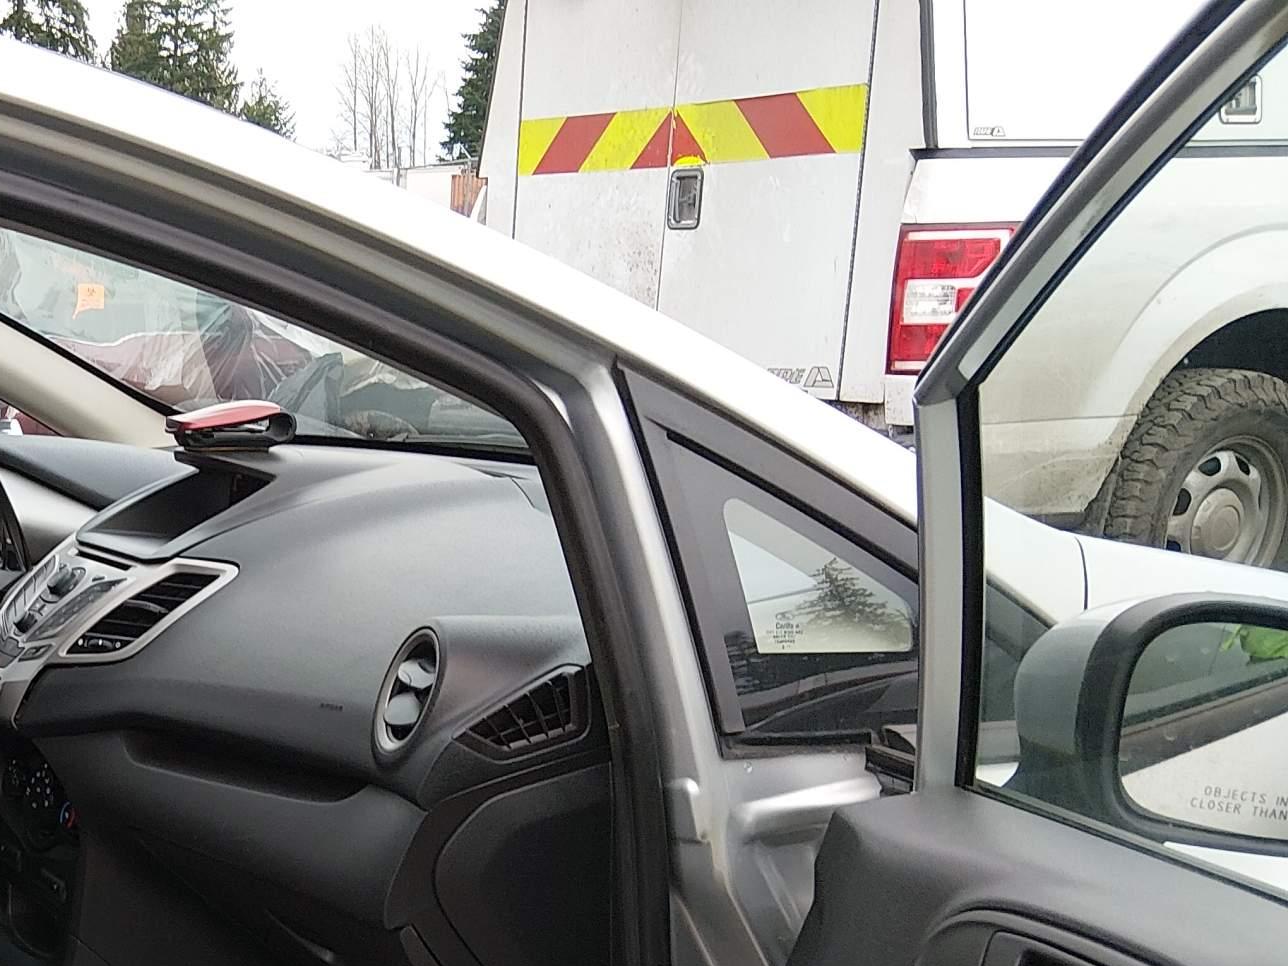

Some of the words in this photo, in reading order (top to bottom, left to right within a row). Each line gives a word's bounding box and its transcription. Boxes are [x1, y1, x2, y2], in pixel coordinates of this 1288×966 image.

[1204, 785, 1267, 804] OBJECTS
[1275, 796, 1288, 807] IN
[1190, 797, 1242, 815] CLOSER
[1253, 806, 1288, 820] THAN
